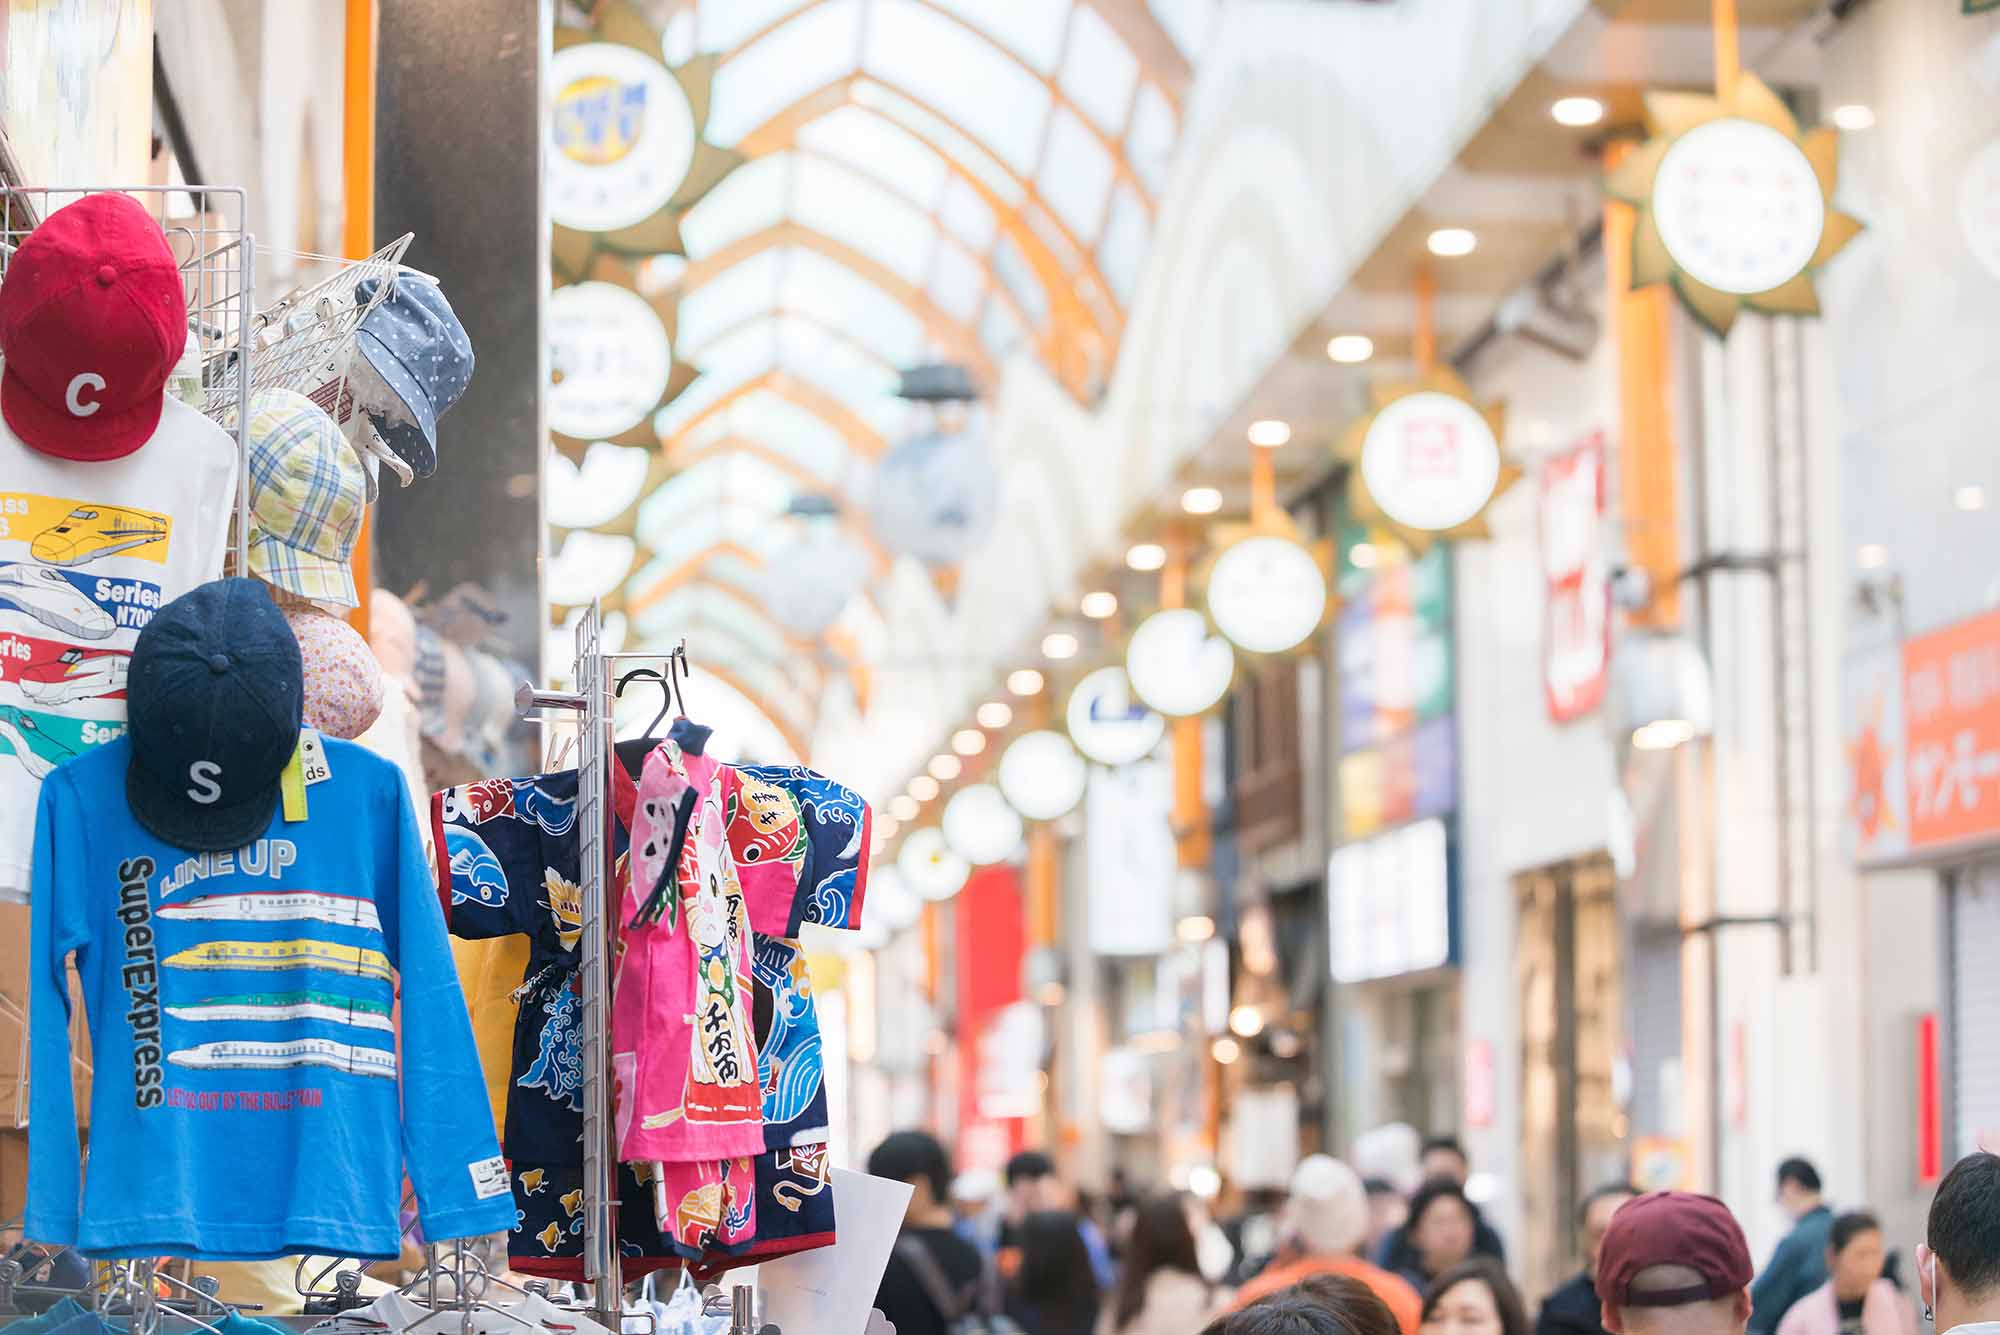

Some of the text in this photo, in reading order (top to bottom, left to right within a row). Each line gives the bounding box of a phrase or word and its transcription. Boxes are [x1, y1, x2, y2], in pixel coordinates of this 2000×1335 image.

[65, 372, 107, 417] C
[94, 578, 160, 609] Series
[187, 760, 223, 804] S
